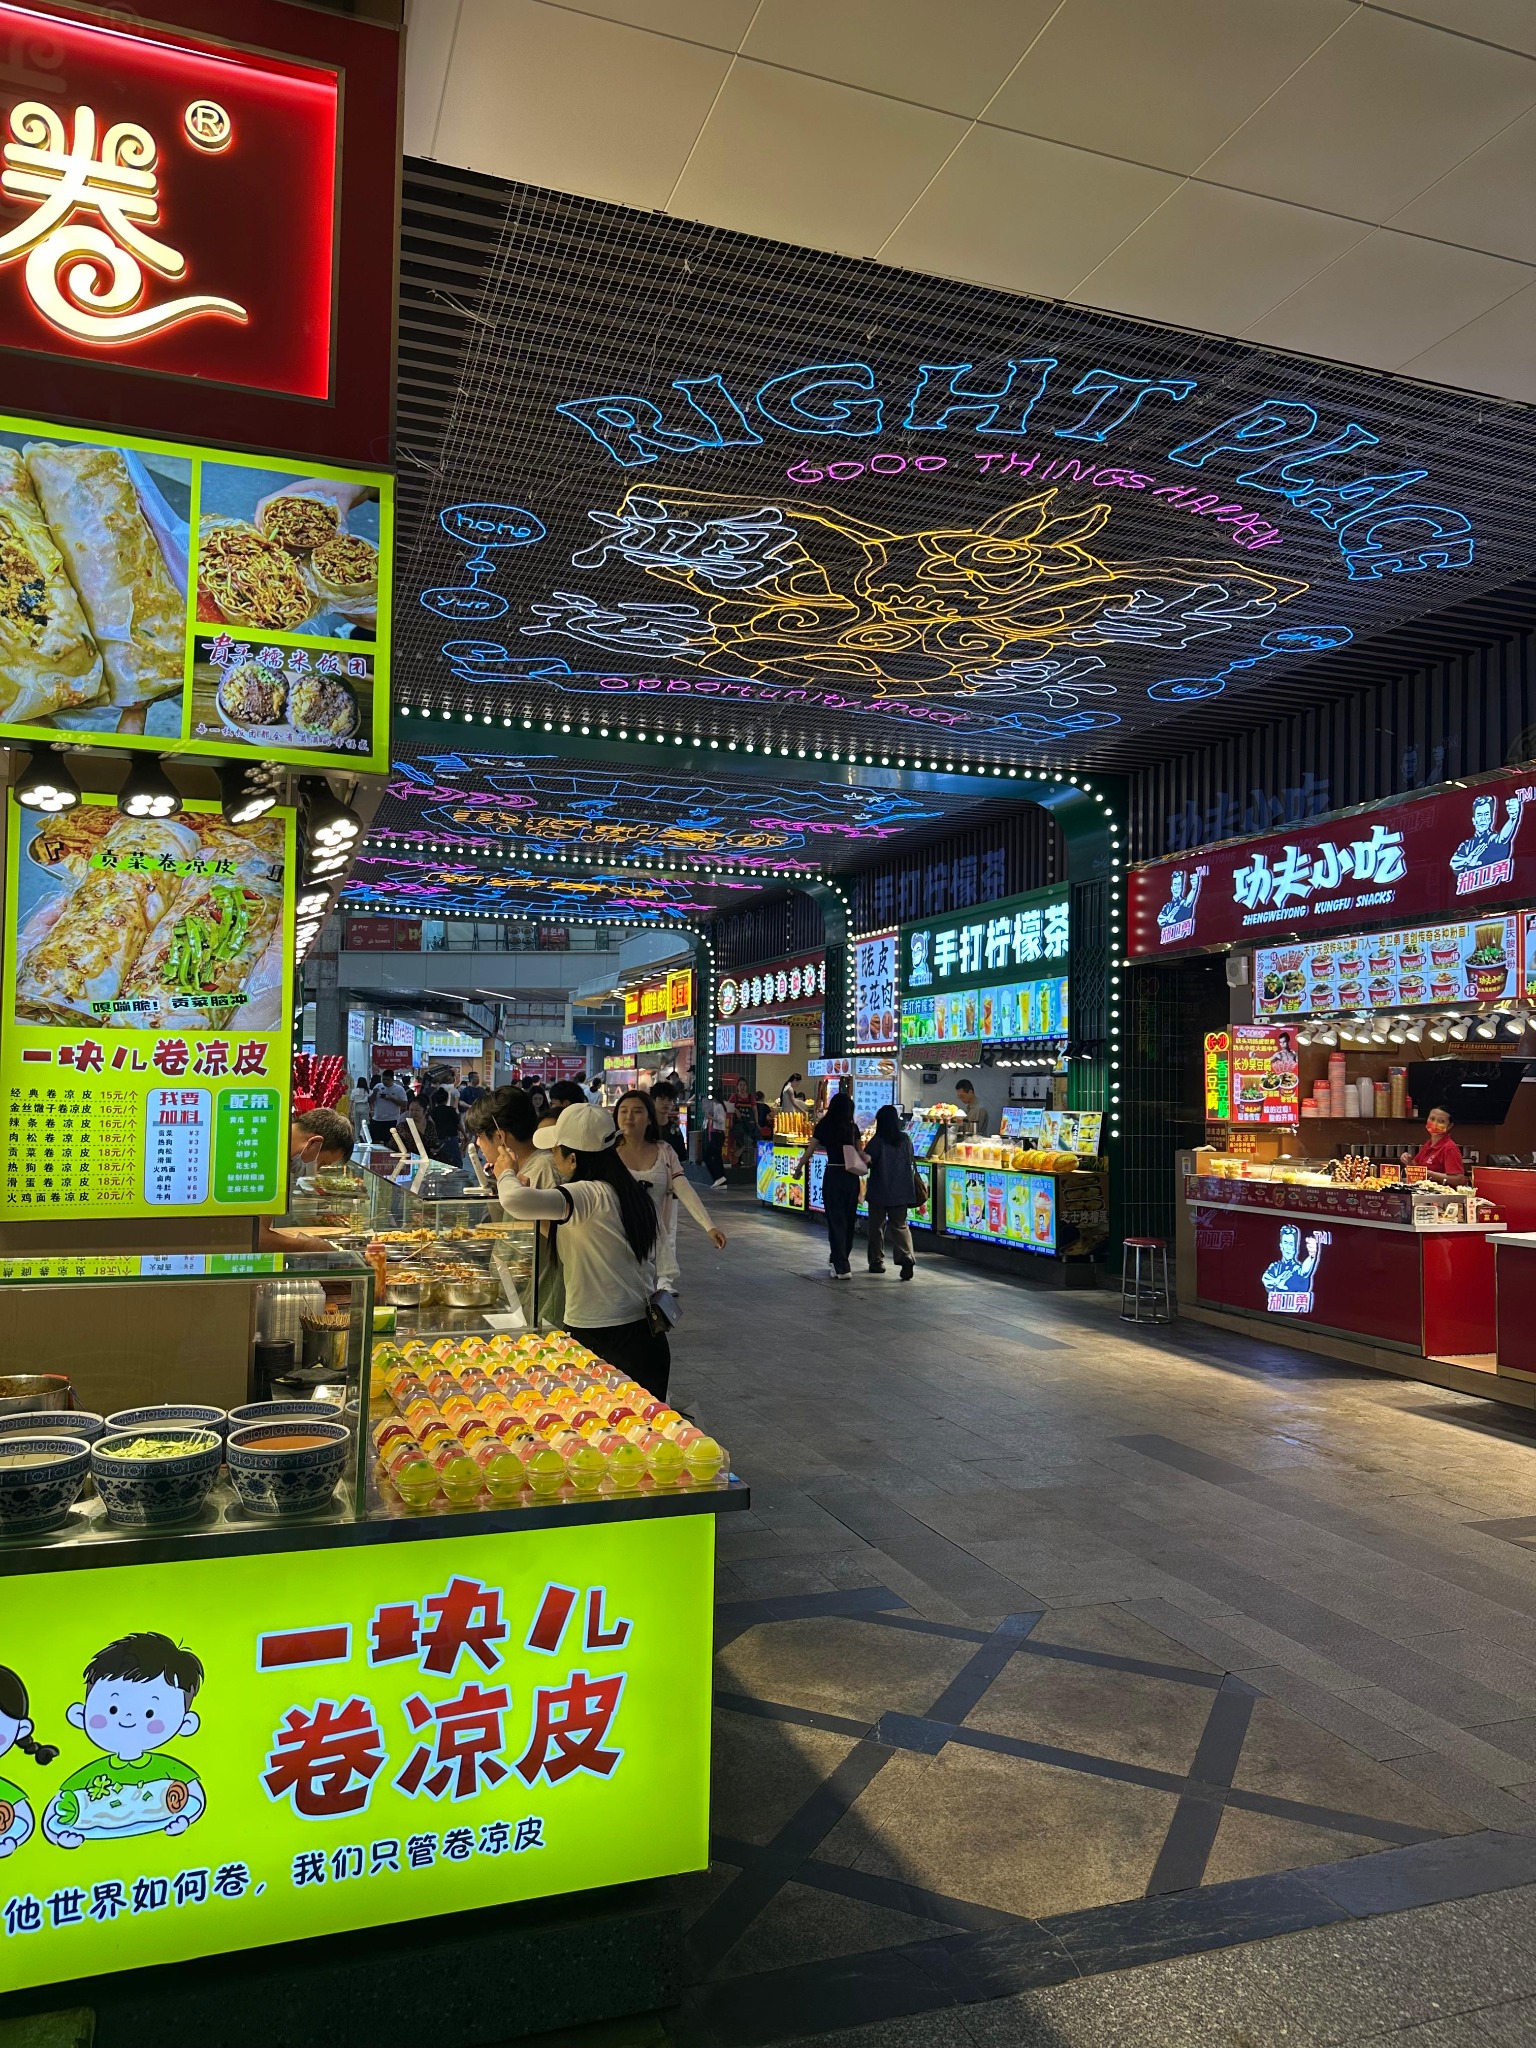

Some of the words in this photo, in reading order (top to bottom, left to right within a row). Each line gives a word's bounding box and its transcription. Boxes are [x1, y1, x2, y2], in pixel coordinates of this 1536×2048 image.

[0, 101, 247, 345] 卷
[556, 358, 1198, 466] RIGHT
[787, 455, 947, 483] GOOD
[976, 451, 1155, 489] THINGS
[1154, 486, 1284, 550] HAPPEN
[457, 513, 532, 538] hong
[600, 678, 860, 709] opportunity
[100, 851, 236, 875] 贡菜卷凉皮
[1232, 824, 1407, 909] 功夫小吃
[1457, 859, 1512, 894] 郑卫勇
[1242, 905, 1309, 926] ZHENGWEIYONG
[1314, 897, 1351, 915] KUNGFU
[1356, 890, 1395, 908] SNACKS
[934, 902, 1068, 977] 手打柠檬茶
[1506, 919, 1516, 969] 重庆酸辣粉
[1465, 985, 1477, 996] 15
[721, 1028, 730, 1051] 39
[753, 1027, 775, 1051] 39
[1207, 1034, 1228, 1050] 长沙
[22, 1038, 270, 1077] 一块儿卷凉皮
[1234, 1058, 1271, 1071] 长沙臭豆腐
[1206, 1052, 1218, 1110] 臭豆腐
[1217, 1059, 1228, 1118] 香豆腐
[10, 1088, 92, 1099] 经典卷凉皮
[101, 1091, 138, 1100] 15元/个
[159, 1092, 199, 1105] 我要
[230, 1094, 269, 1108] 配菜
[100, 1105, 138, 1114] 16元/个
[159, 1110, 199, 1125] 加料
[9, 1118, 91, 1128] 辣条卷凉皮
[100, 1119, 137, 1128] 16元/个
[9, 1132, 90, 1143] 肉松卷凉皮
[99, 1133, 137, 1143] 18元/个
[8, 1147, 90, 1158] 贡菜卷凉皮
[99, 1148, 136, 1157] 18元/个
[7, 1162, 90, 1172] 热狗卷凉皮
[98, 1162, 136, 1171] 18元/个
[7, 1177, 89, 1187] 滑蛋卷凉皮
[98, 1176, 136, 1186] 18元/个
[7, 1192, 89, 1203] 火鸡面卷凉皮
[97, 1191, 135, 1200] 20元/个
[257, 1577, 632, 1674] 一块儿
[261, 1673, 626, 1819] 卷凉皮
[293, 1817, 545, 1888] 我们只管卷凉皮
